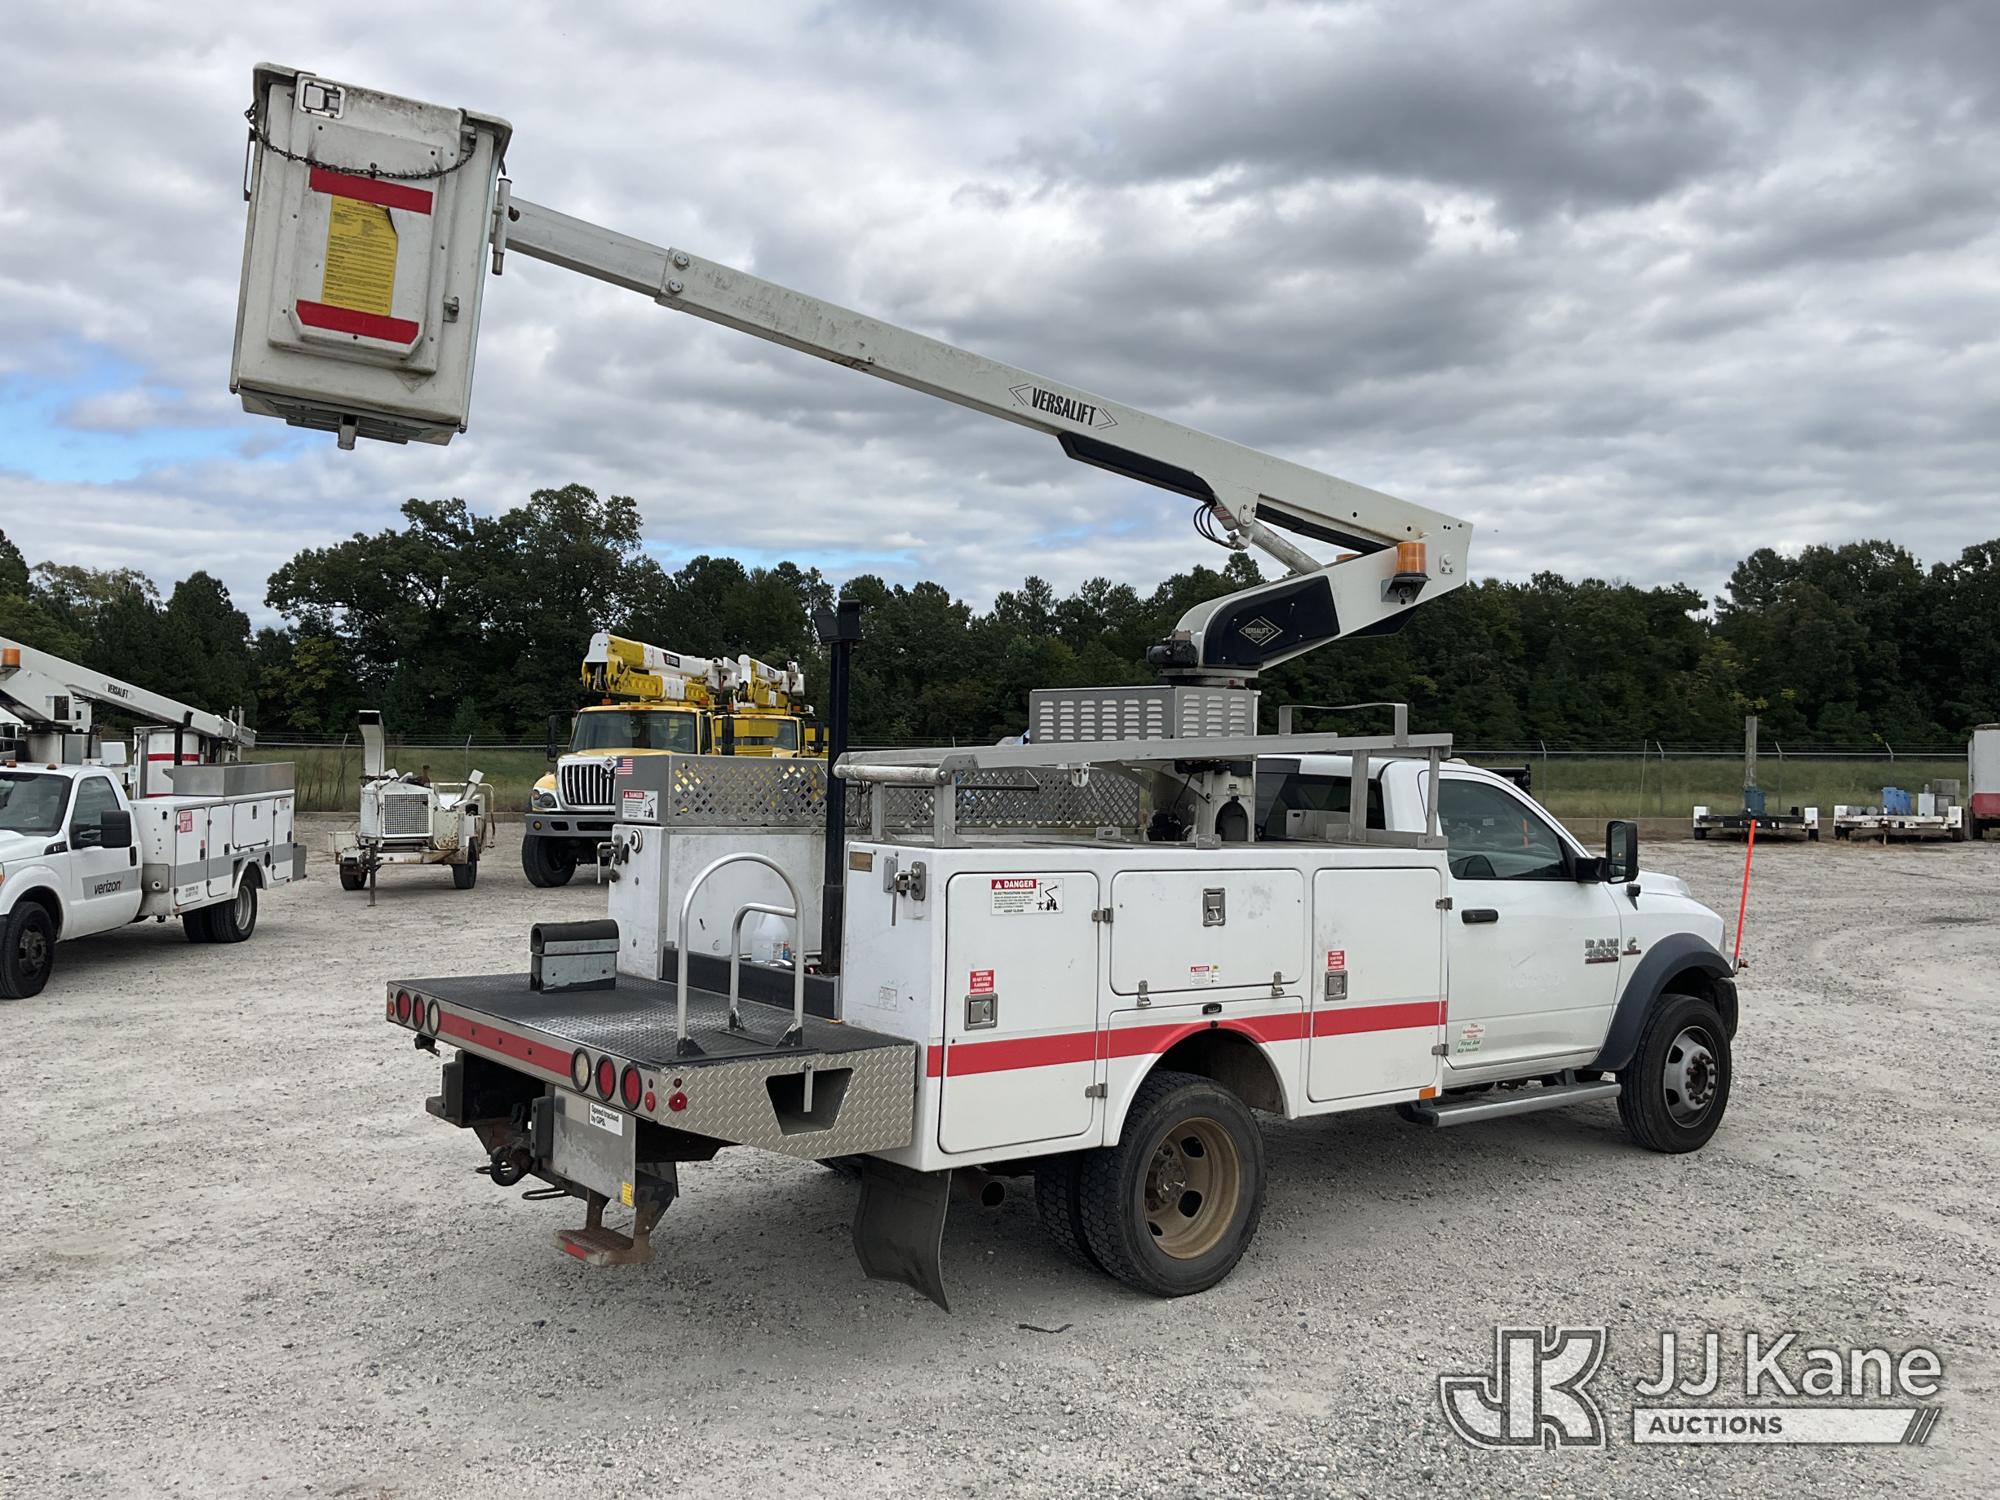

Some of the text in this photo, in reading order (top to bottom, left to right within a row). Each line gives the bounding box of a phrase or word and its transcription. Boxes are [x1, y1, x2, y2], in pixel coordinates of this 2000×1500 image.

[1031, 387, 1097, 426] VERSALIFT
[107, 683, 129, 699] VERSALIFT
[94, 880, 121, 895] verizon
[1003, 880, 1034, 889] DANGER
[1584, 938, 1619, 949] RAM
[591, 1104, 604, 1116] Speed
